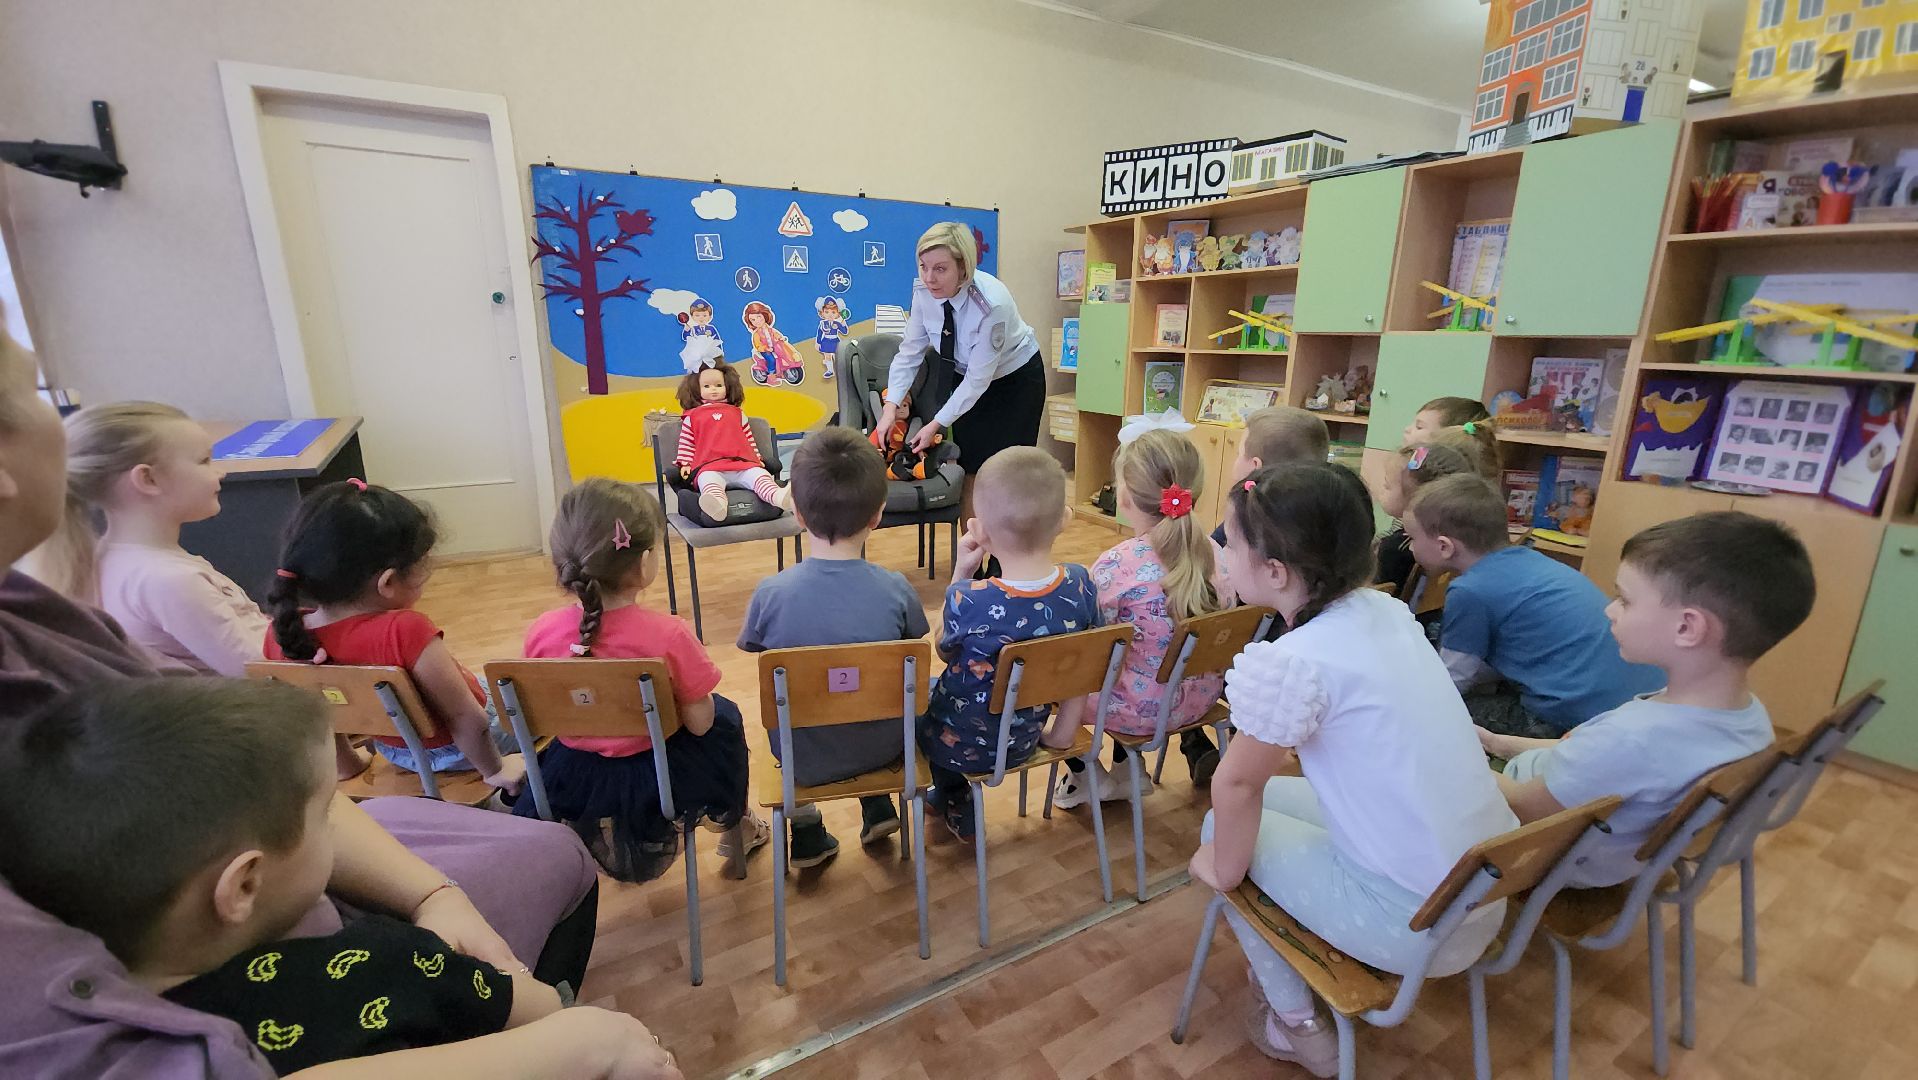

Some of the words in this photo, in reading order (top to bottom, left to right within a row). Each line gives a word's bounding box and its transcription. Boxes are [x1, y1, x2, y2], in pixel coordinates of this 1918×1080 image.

[1110, 160, 1226, 196] КИНО
[839, 672, 849, 685] 2
[580, 693, 590, 704] 2
